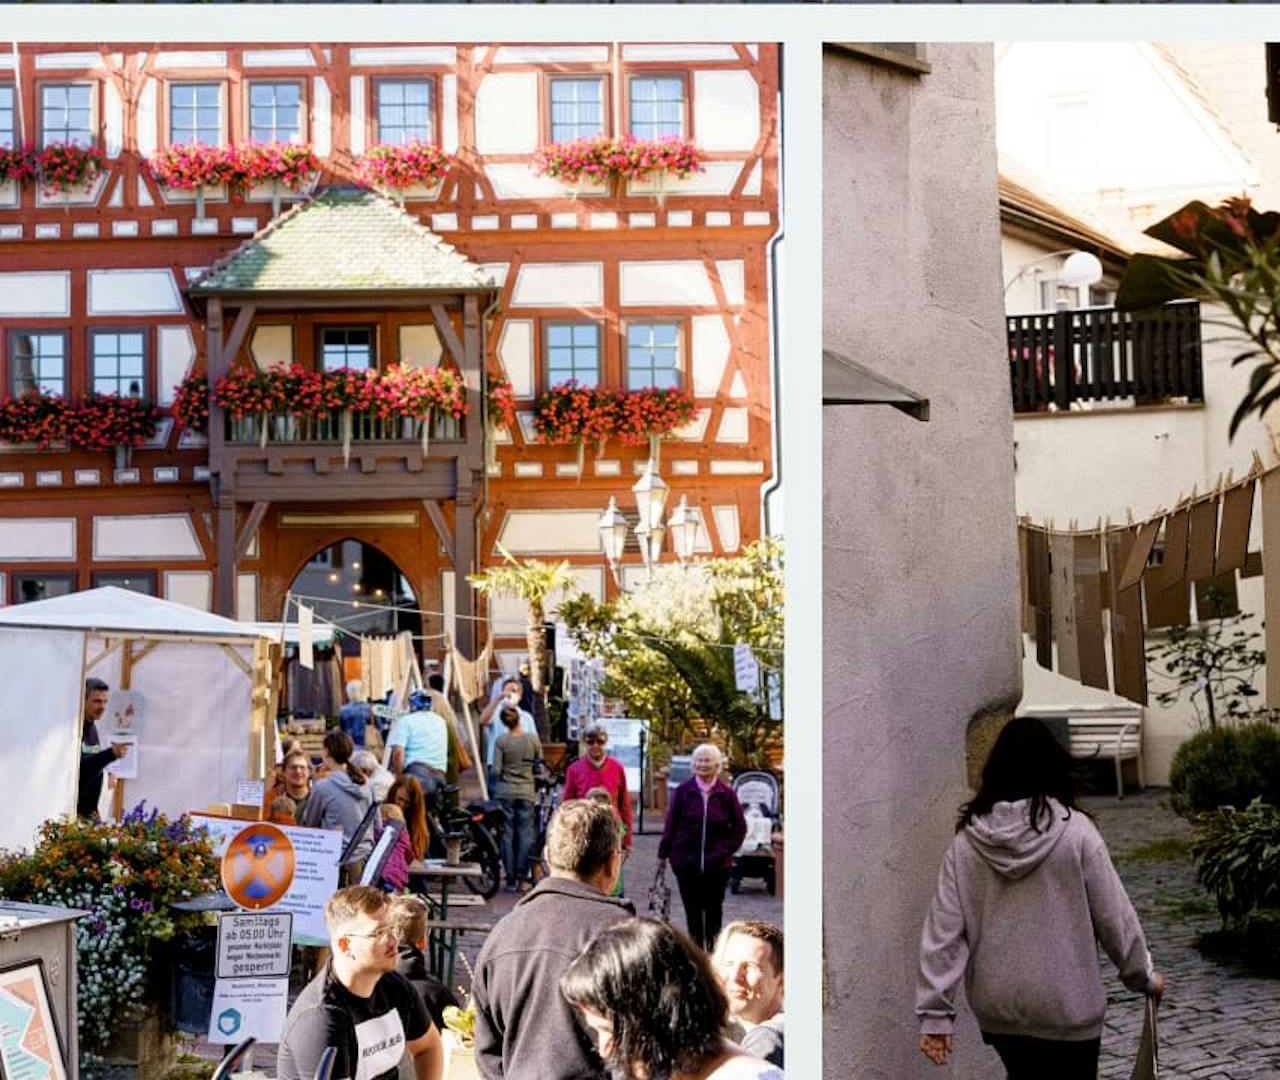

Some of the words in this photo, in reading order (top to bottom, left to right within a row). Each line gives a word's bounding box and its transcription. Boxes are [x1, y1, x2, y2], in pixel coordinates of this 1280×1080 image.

[232, 917, 280, 928] Samstags
[226, 930, 238, 940] ab
[268, 926, 286, 938] Uhr
